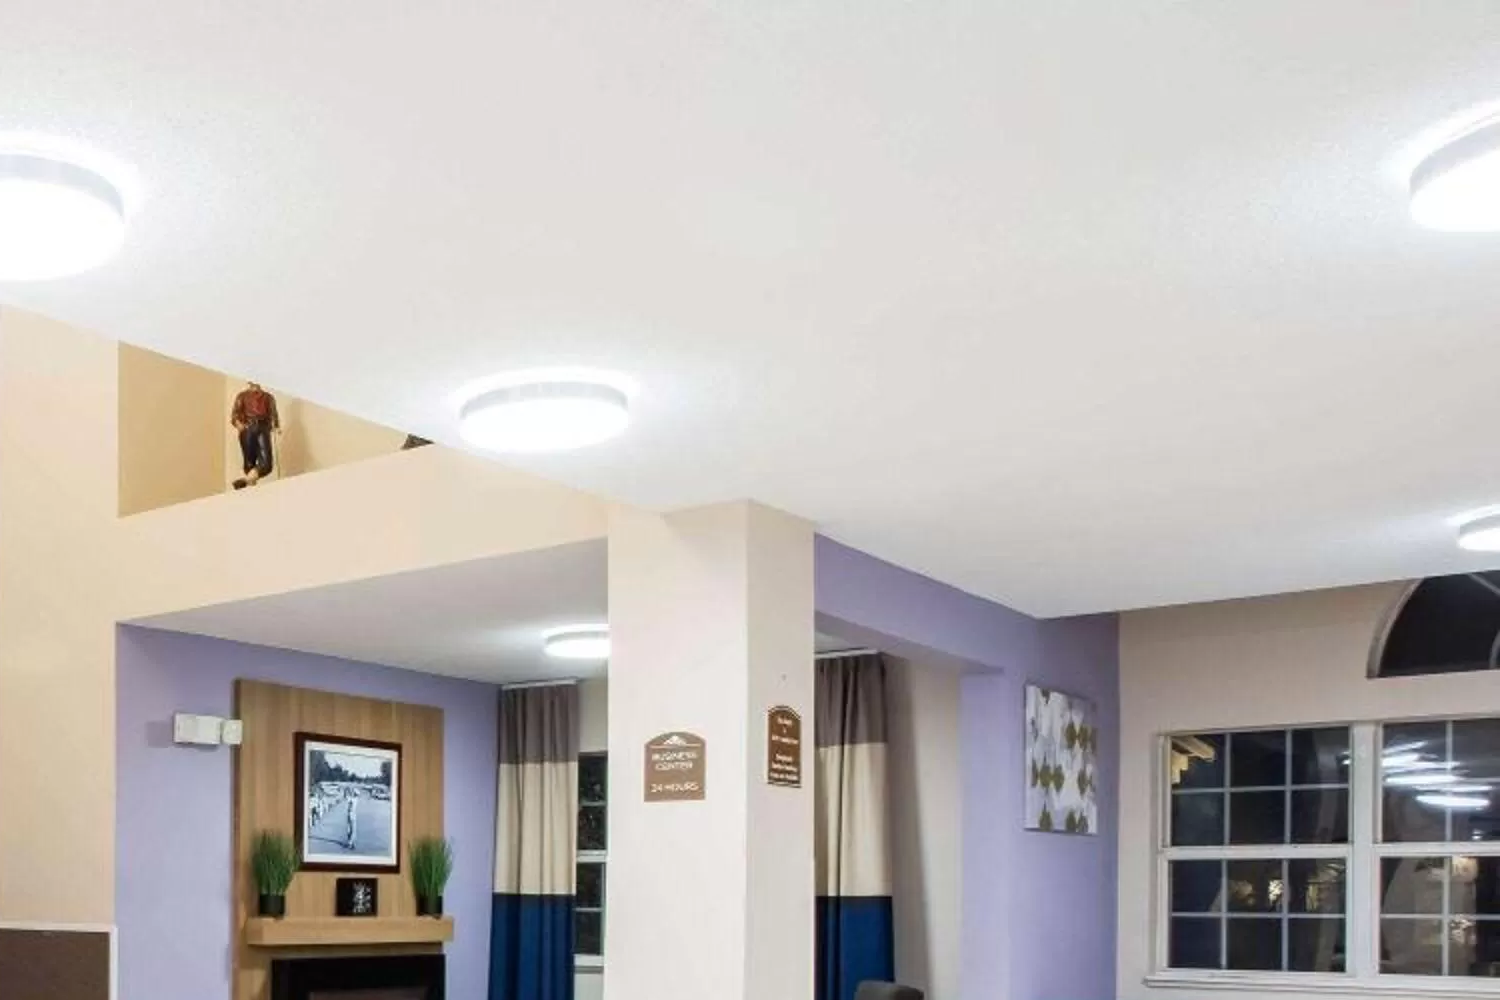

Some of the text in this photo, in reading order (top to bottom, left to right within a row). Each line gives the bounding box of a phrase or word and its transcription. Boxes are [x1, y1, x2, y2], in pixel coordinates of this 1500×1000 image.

[651, 751, 697, 760] BUSINESS
[655, 761, 693, 770] CENTER
[650, 781, 699, 792] 24 HOURS
